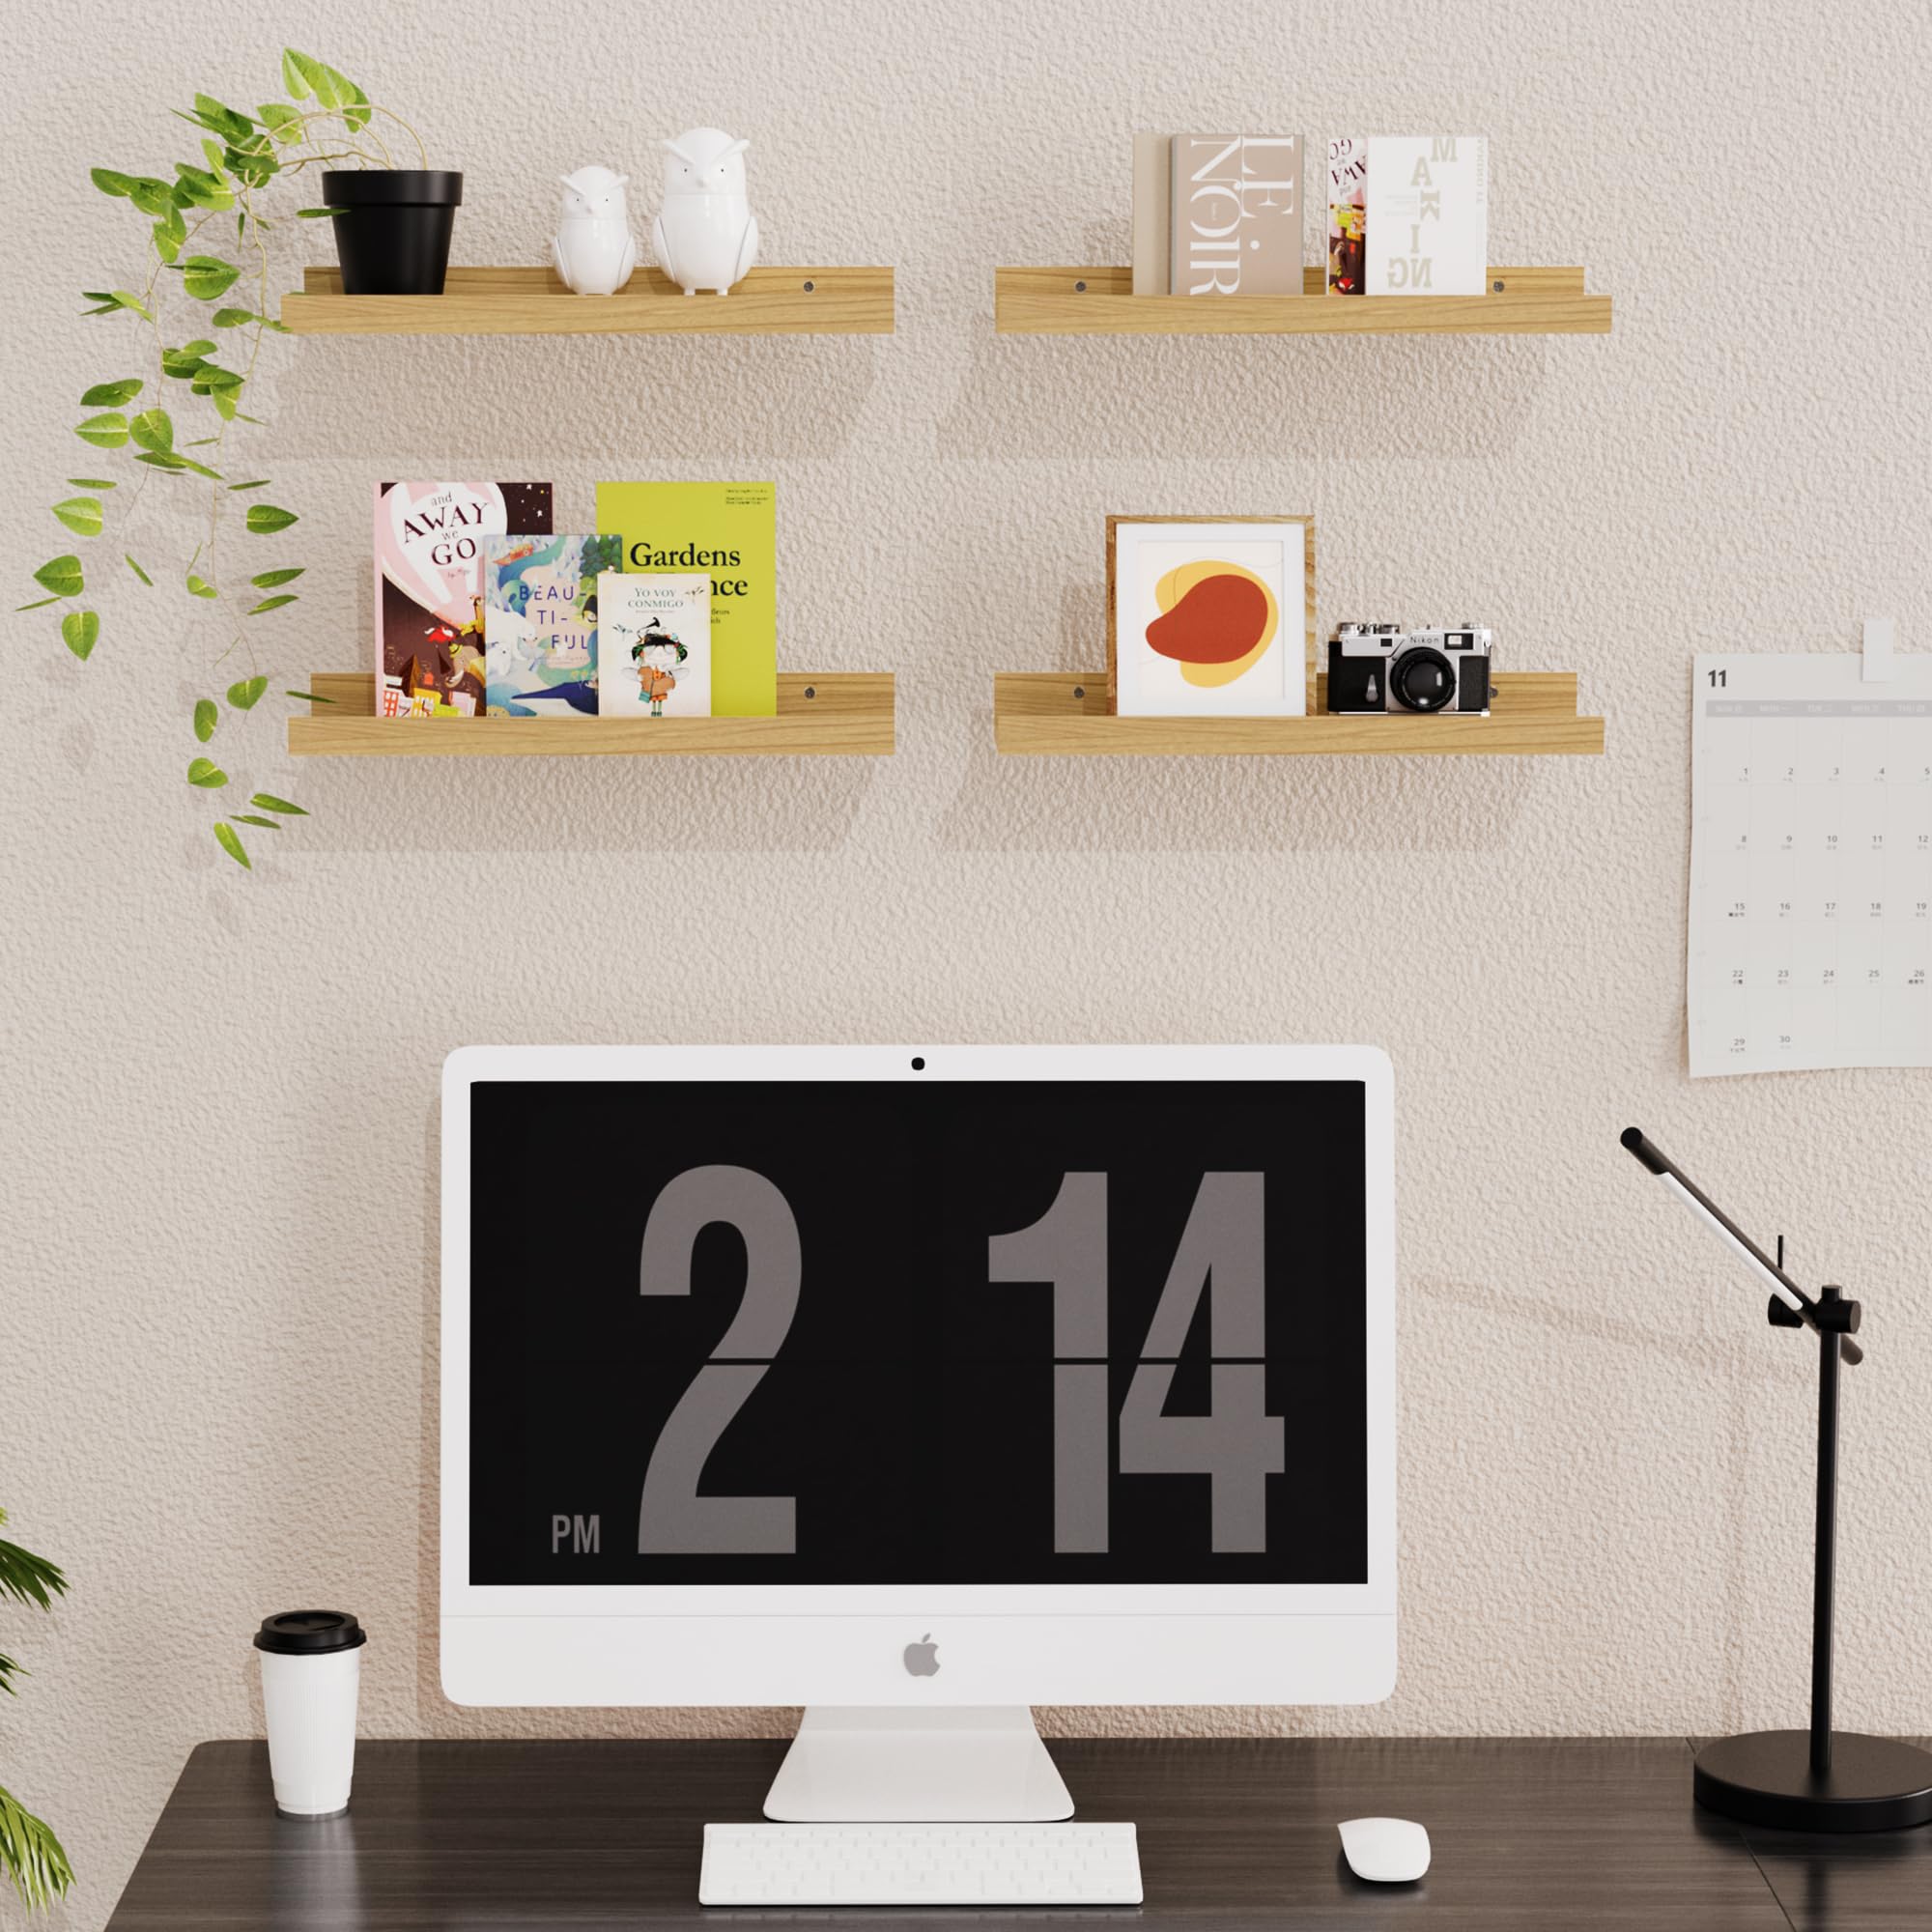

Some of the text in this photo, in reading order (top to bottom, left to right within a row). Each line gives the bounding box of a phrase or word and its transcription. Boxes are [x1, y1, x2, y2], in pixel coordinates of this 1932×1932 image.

[1240, 135, 1294, 219] LE
[431, 492, 453, 506] and
[403, 502, 489, 543] AWAY
[441, 529, 459, 541] we
[431, 537, 476, 566] GO
[629, 542, 741, 567] Gardens
[519, 584, 587, 601] BEAU-
[627, 600, 684, 609] CONMIGO
[536, 610, 568, 625] TI-
[551, 634, 588, 650] FUL
[1409, 636, 1439, 644] Nikon
[1707, 668, 1727, 688] 11
[638, 1164, 1287, 1554] 2 14
[551, 1514, 601, 1554] PM
